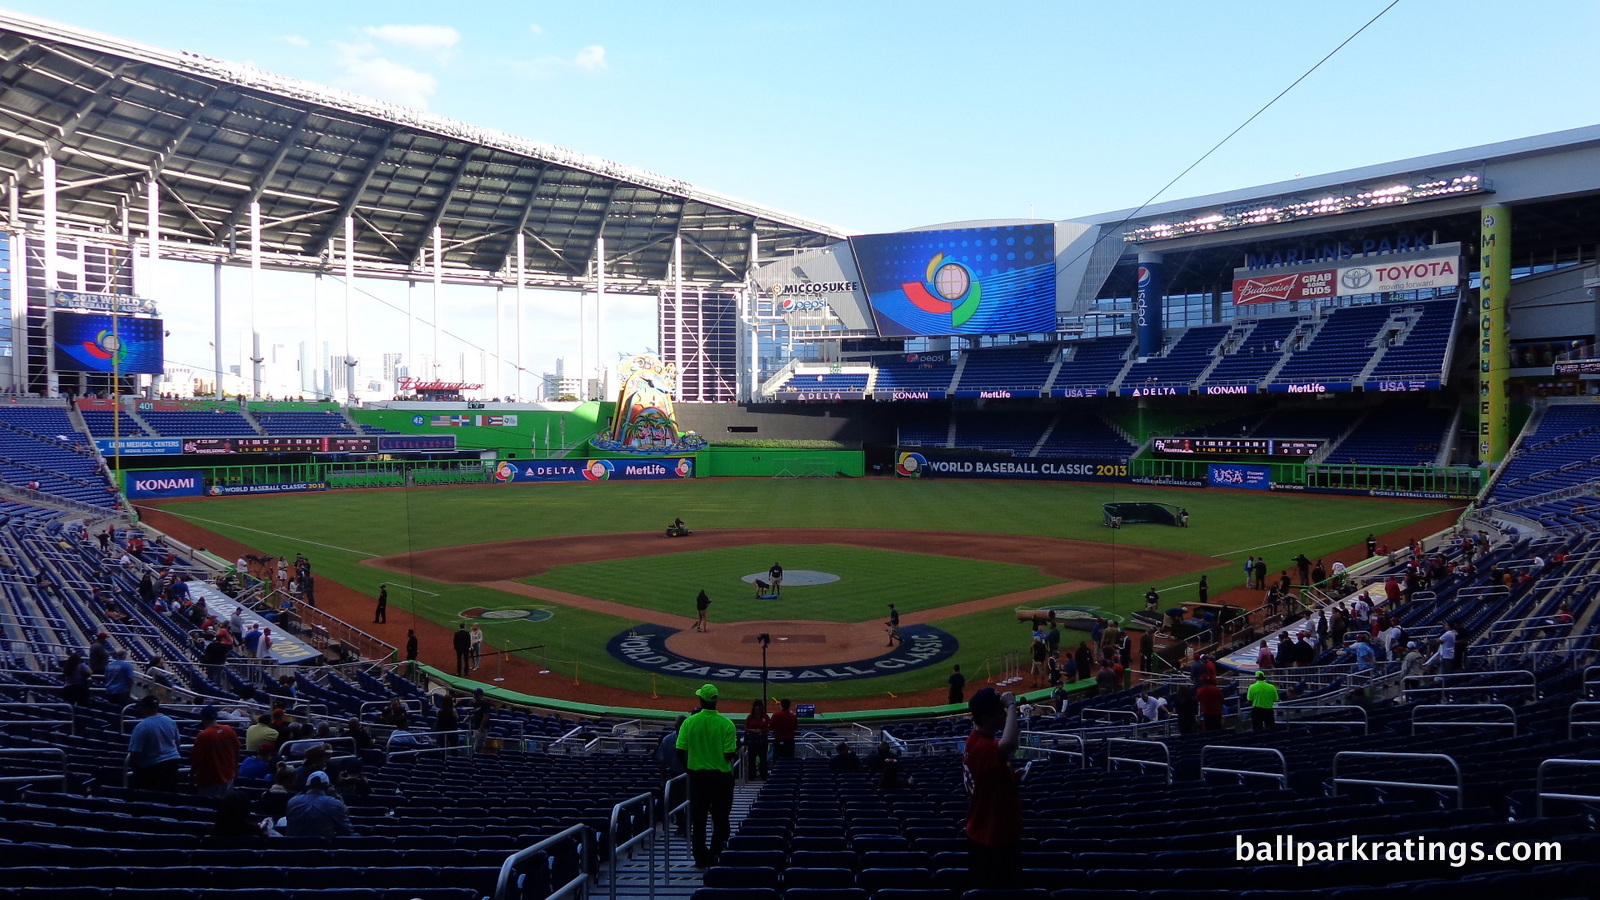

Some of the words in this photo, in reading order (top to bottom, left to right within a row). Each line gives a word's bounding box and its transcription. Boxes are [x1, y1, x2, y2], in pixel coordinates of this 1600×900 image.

[1249, 244, 1353, 270] MARLINS
[1362, 234, 1429, 257] PARK
[1376, 261, 1454, 281] TOYOTA
[1302, 273, 1332, 283] GRAB
[784, 282, 857, 293] MICCOSUKEE
[1238, 283, 1295, 296] Budweiser
[1379, 283, 1404, 291] moving
[1406, 279, 1434, 288] forward
[1302, 286, 1331, 296] BUDS
[796, 299, 827, 310] pepsi
[1138, 289, 1147, 326] pepsi
[397, 376, 485, 390] Budweiser
[1287, 383, 1326, 393] MetLife
[1379, 381, 1406, 391] USA
[980, 391, 1011, 399] MetLife
[1065, 389, 1084, 397] USA
[1143, 387, 1176, 396] DELTA
[1207, 386, 1247, 395] KONAMI
[892, 392, 929, 400] KONAMI
[139, 402, 154, 410] 401
[413, 416, 424, 424] 42
[537, 467, 576, 475] DELTA
[626, 465, 666, 475] MetLife
[928, 461, 973, 473] WORLD
[976, 463, 1038, 474] BASEBALL
[1041, 464, 1093, 475] CLASSIC
[1096, 465, 1127, 476] 2013
[1213, 468, 1243, 484] USA
[136, 478, 194, 490] KONAMI
[620, 634, 668, 664] WORLD
[661, 661, 876, 680] BASEBALL
[874, 634, 943, 669] CLASSIC
